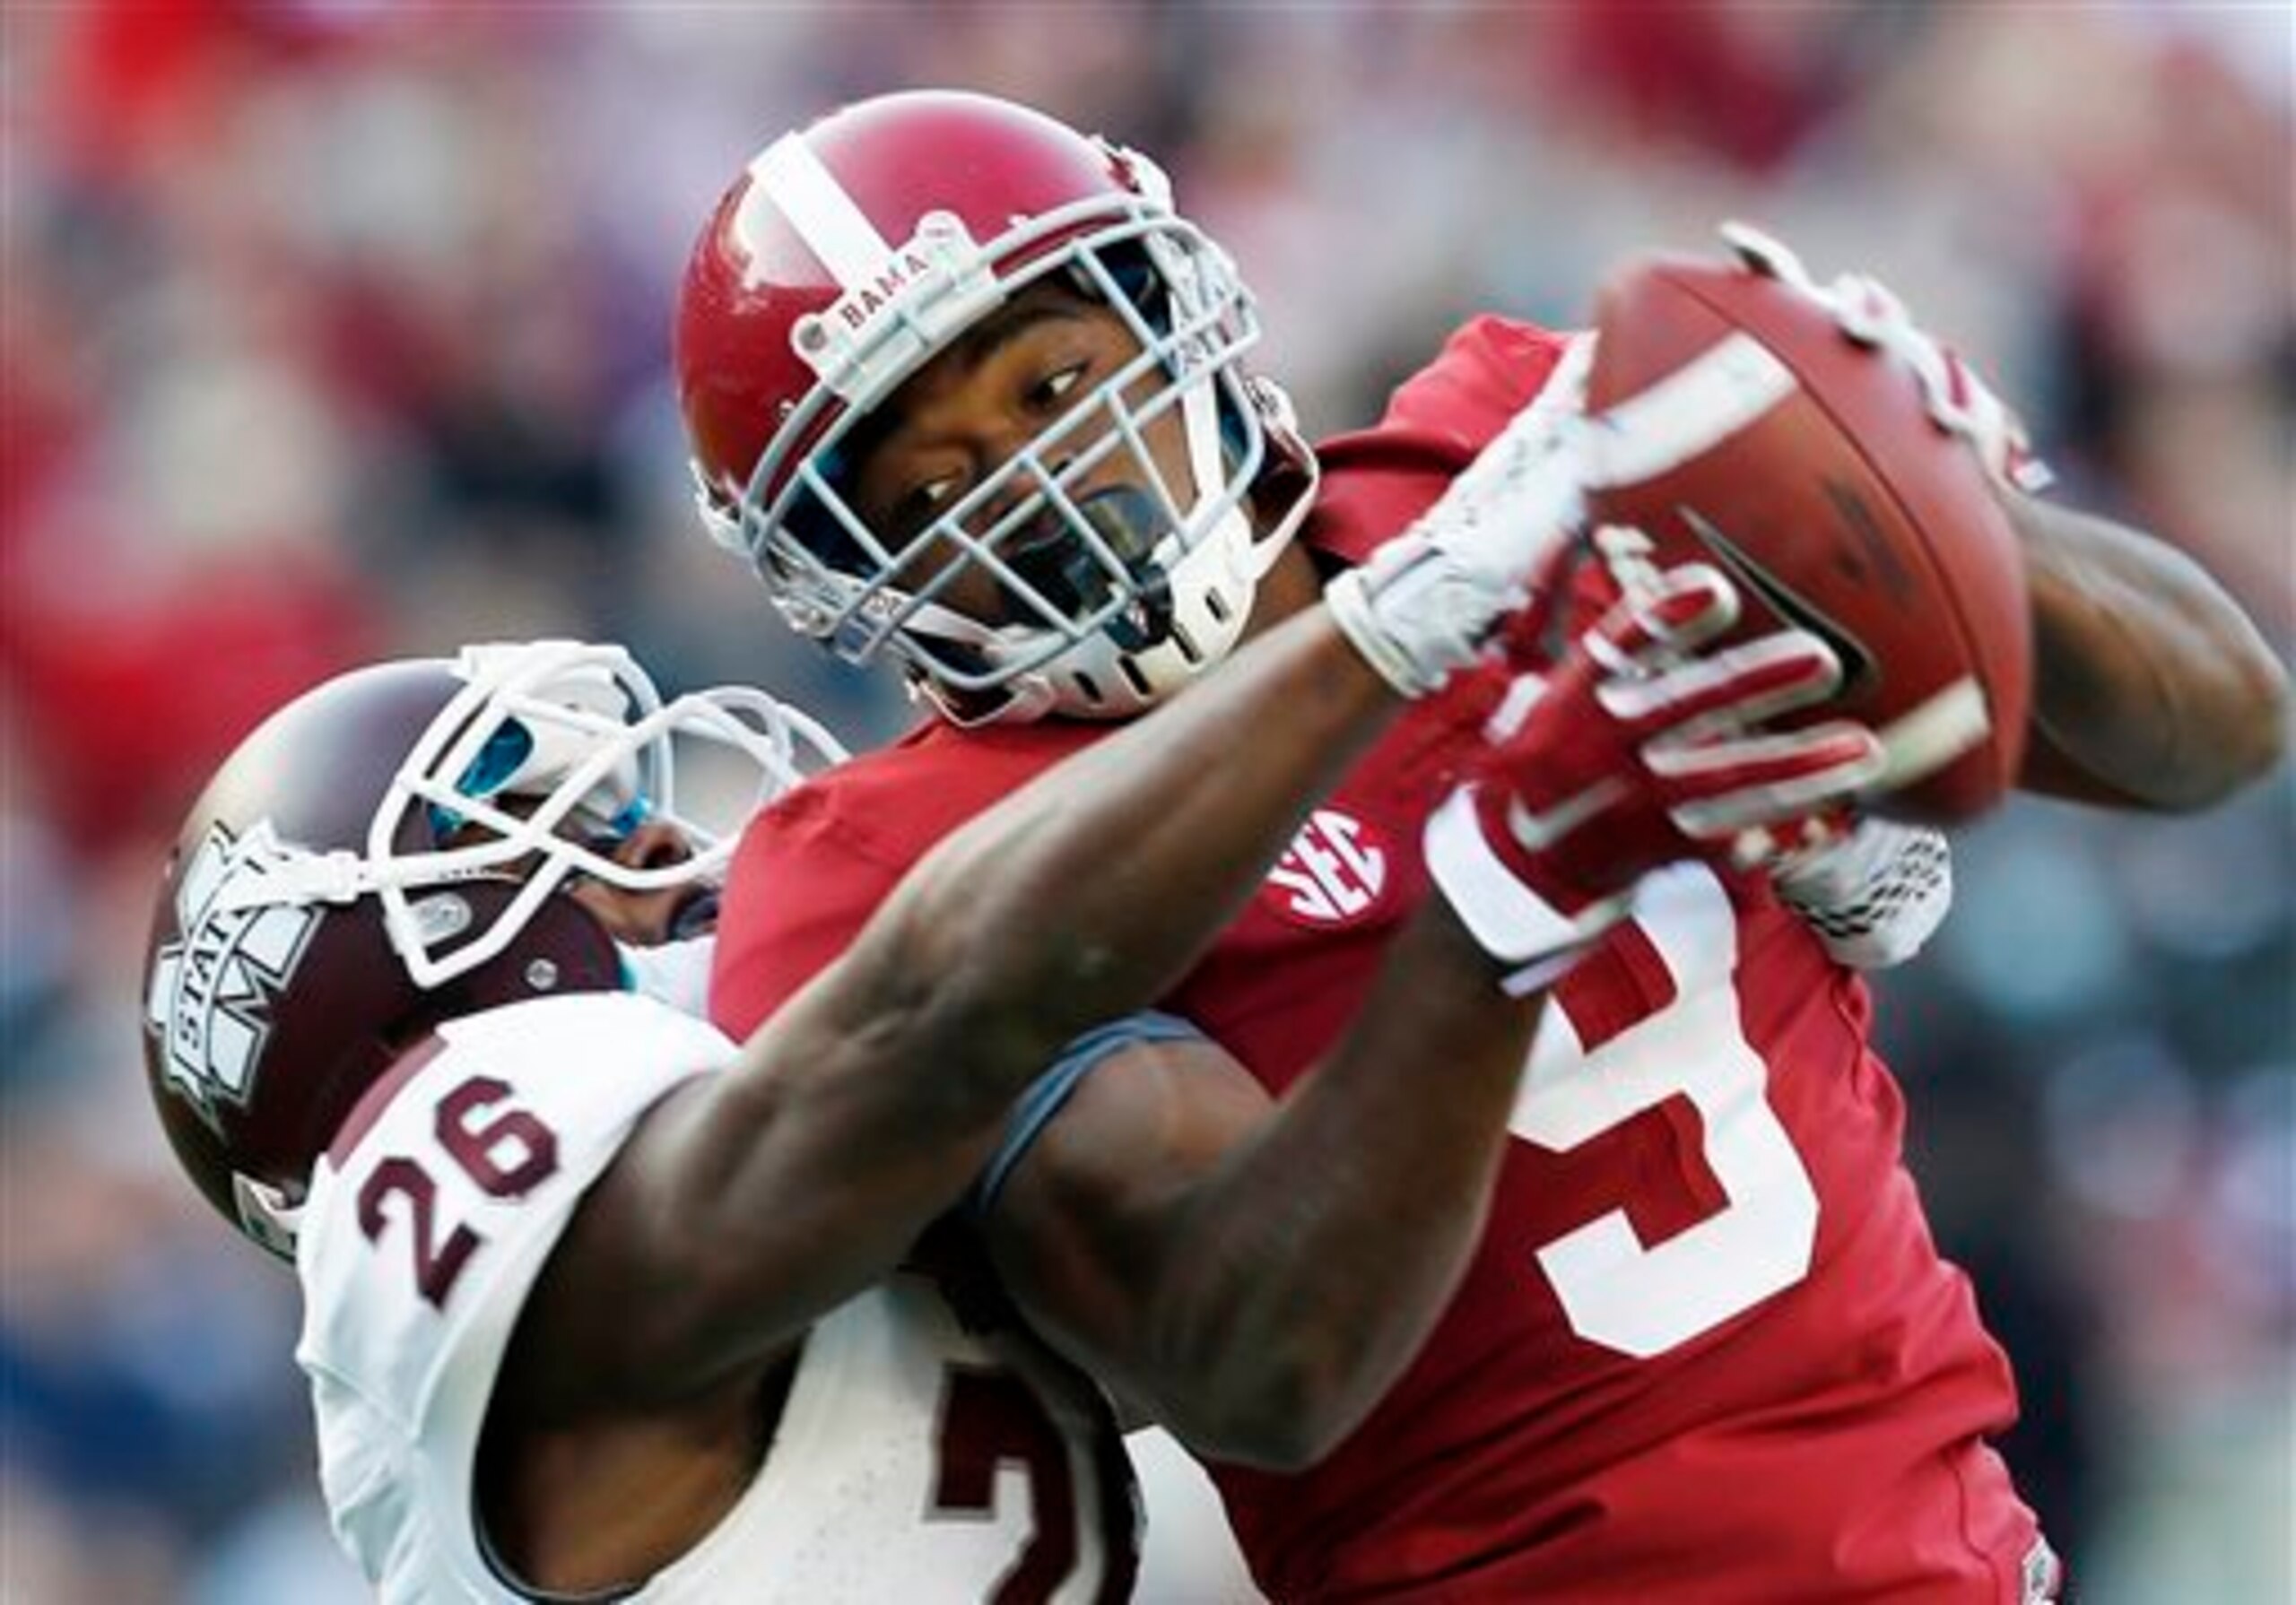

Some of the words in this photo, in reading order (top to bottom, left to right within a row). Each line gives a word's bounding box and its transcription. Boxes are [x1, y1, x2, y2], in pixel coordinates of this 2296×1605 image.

[839, 254, 928, 329] BAMA
[1267, 809, 1386, 921] SEC
[178, 906, 244, 1051] STAT
[1507, 858, 1822, 1360] 9
[356, 1074, 561, 1313] 26
